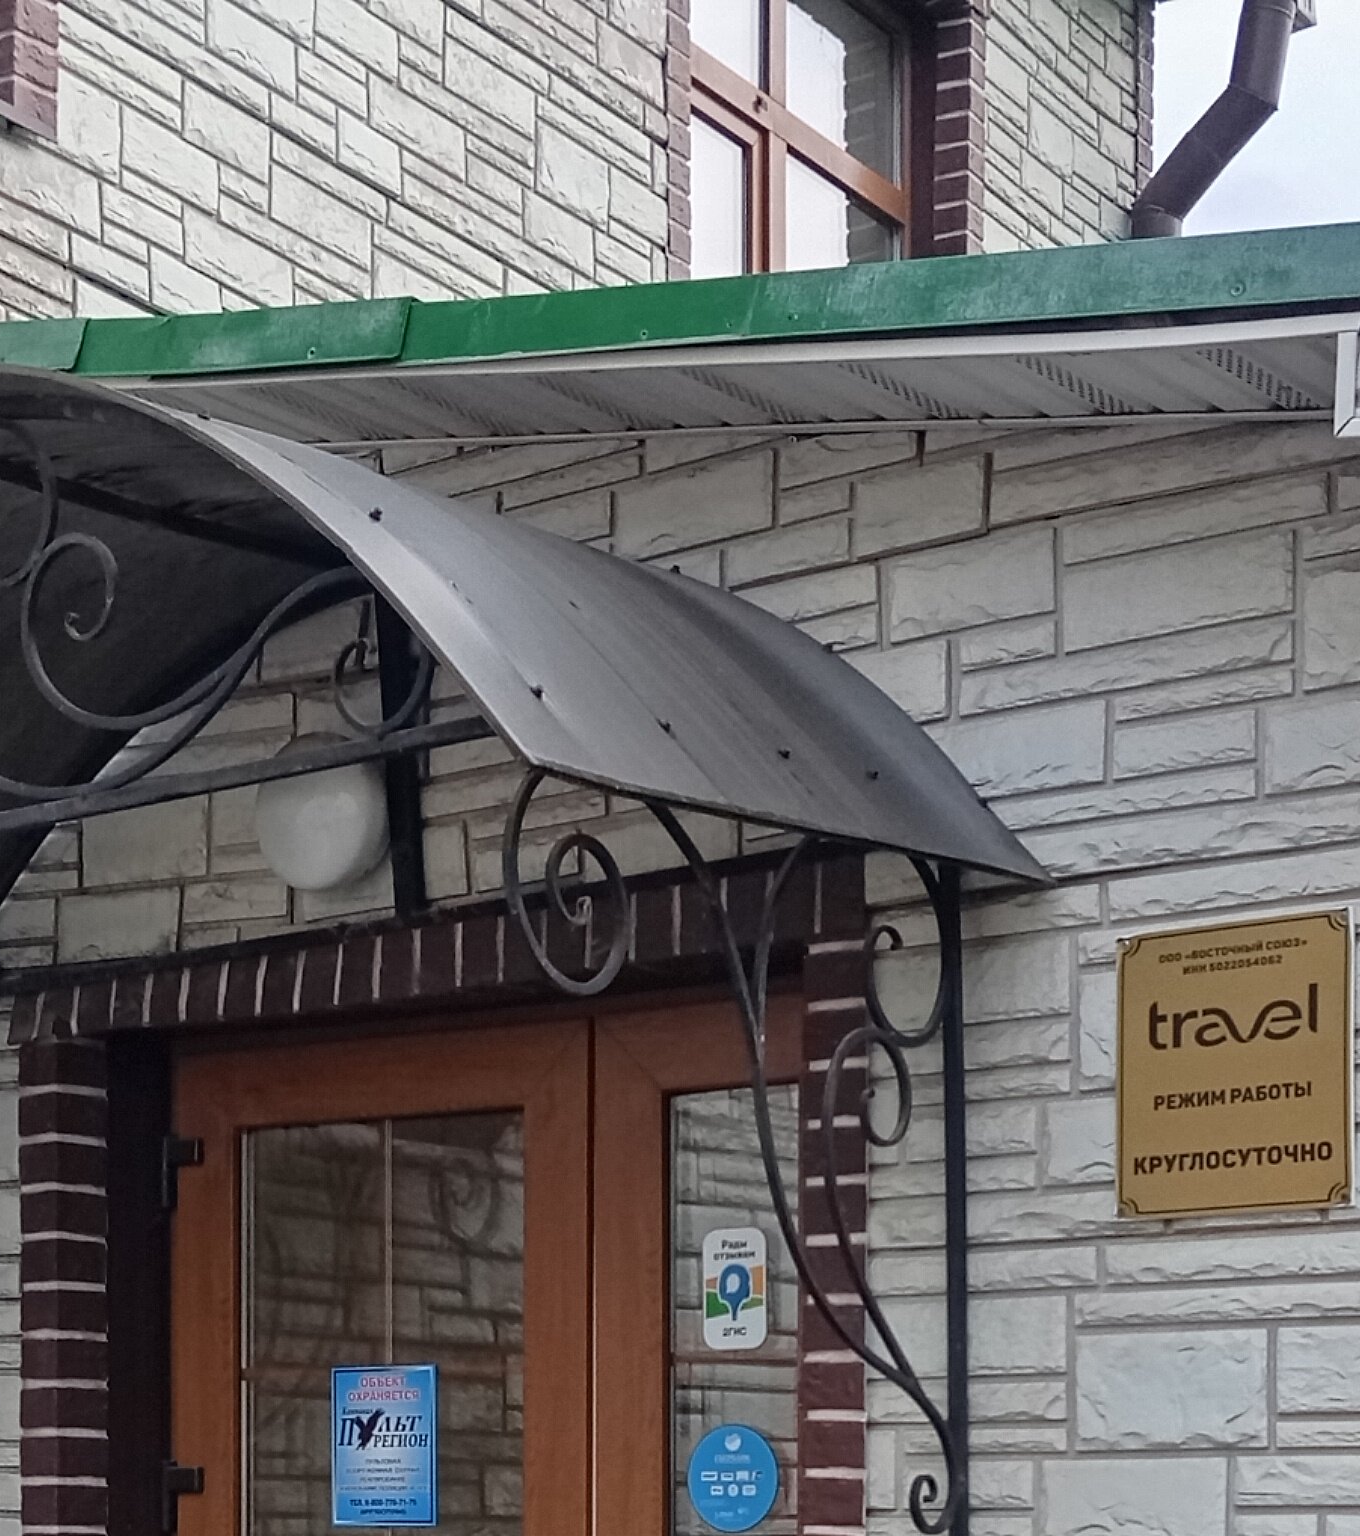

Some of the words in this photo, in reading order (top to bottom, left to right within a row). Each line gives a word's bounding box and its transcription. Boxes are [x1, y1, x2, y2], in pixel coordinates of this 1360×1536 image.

[1158, 952, 1182, 964] ООО
[1182, 964, 1208, 975] ИНН
[1148, 982, 1319, 1051] travel
[1153, 1085, 1226, 1111] РЕЖИМ
[1230, 1080, 1312, 1105] РАБОТЫ
[1133, 1141, 1334, 1176] КРУГЛОСУТОЧНО
[721, 1239, 748, 1250] Рады
[713, 1250, 756, 1261] отзывам
[722, 1327, 748, 1337] 2ГИС
[361, 1376, 405, 1388] ОБЪЕКТ
[347, 1390, 419, 1401] ОХРАНЯЕТСЯ
[373, 1433, 429, 1448] РЕГИОН
